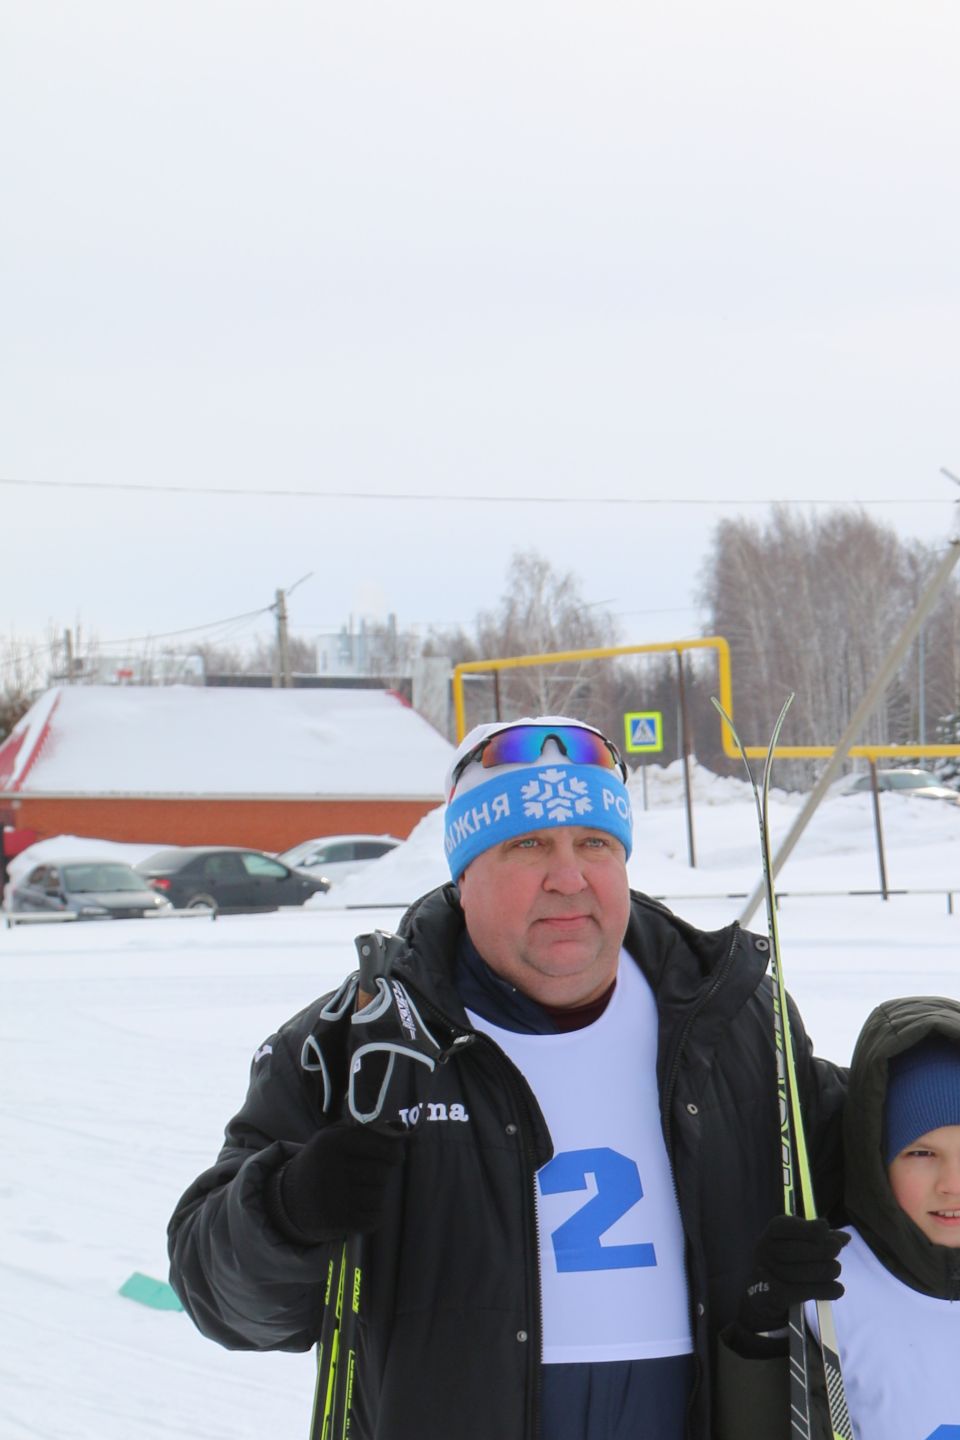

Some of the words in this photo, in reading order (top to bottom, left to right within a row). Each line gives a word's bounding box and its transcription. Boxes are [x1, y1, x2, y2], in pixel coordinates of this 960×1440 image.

[445, 793, 510, 851] ЫЖНЯ
[602, 788, 632, 825] РО
[538, 1147, 657, 1272] 2
